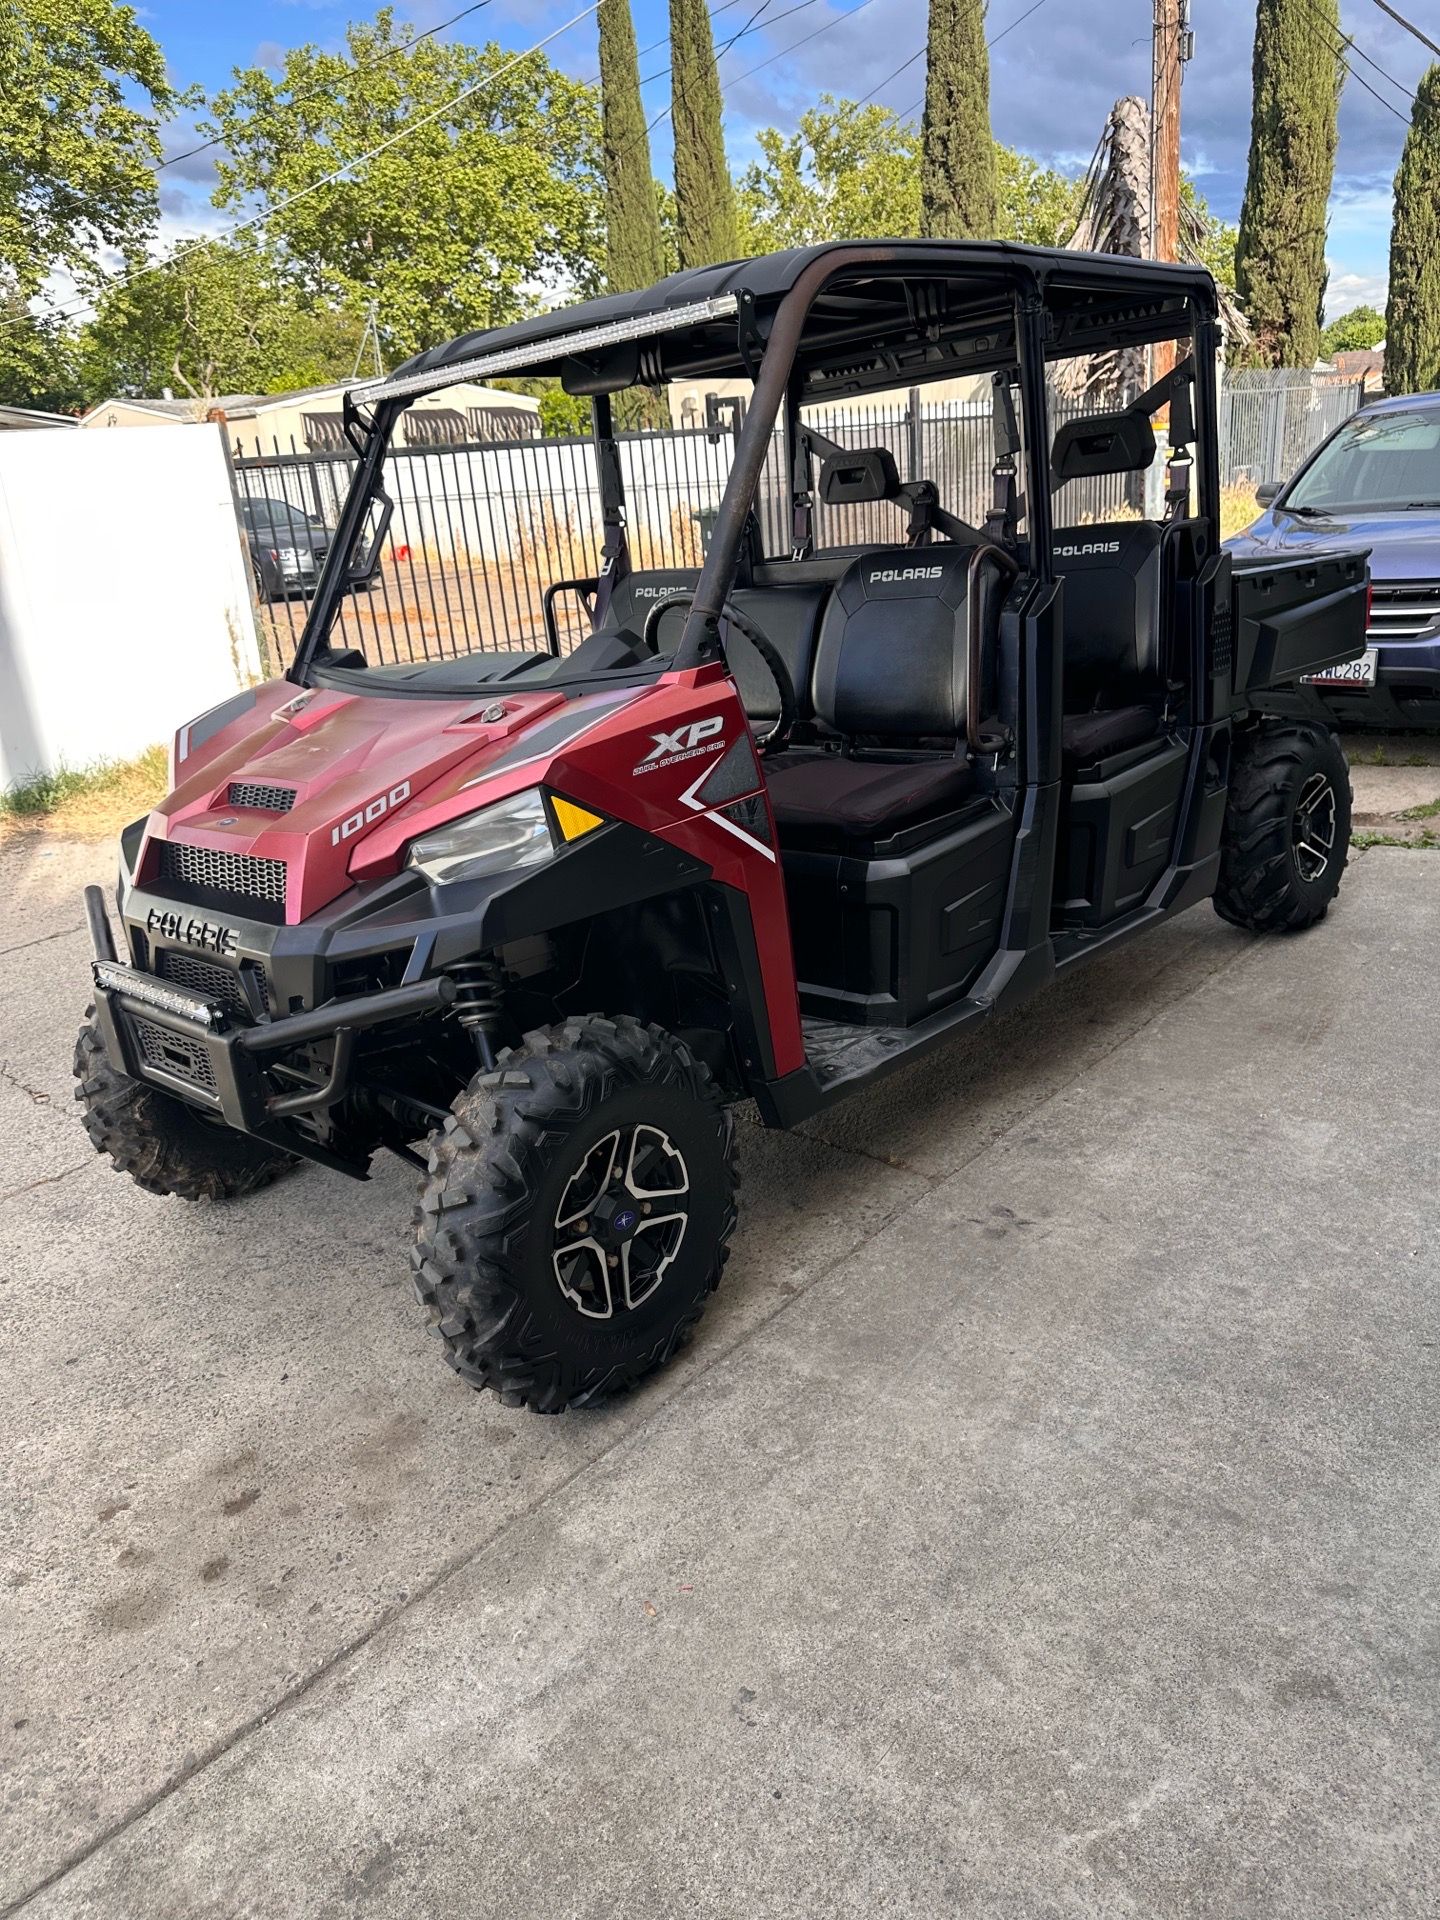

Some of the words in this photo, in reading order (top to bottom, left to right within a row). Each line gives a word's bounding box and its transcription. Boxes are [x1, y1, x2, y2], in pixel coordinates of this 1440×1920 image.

[1053, 541, 1120, 556] POLARIS
[869, 566, 943, 583] POLARIS
[635, 586, 688, 598] POLAR
[642, 715, 724, 763] XP
[331, 780, 411, 847] 1000
[147, 908, 241, 958] POLARIS
